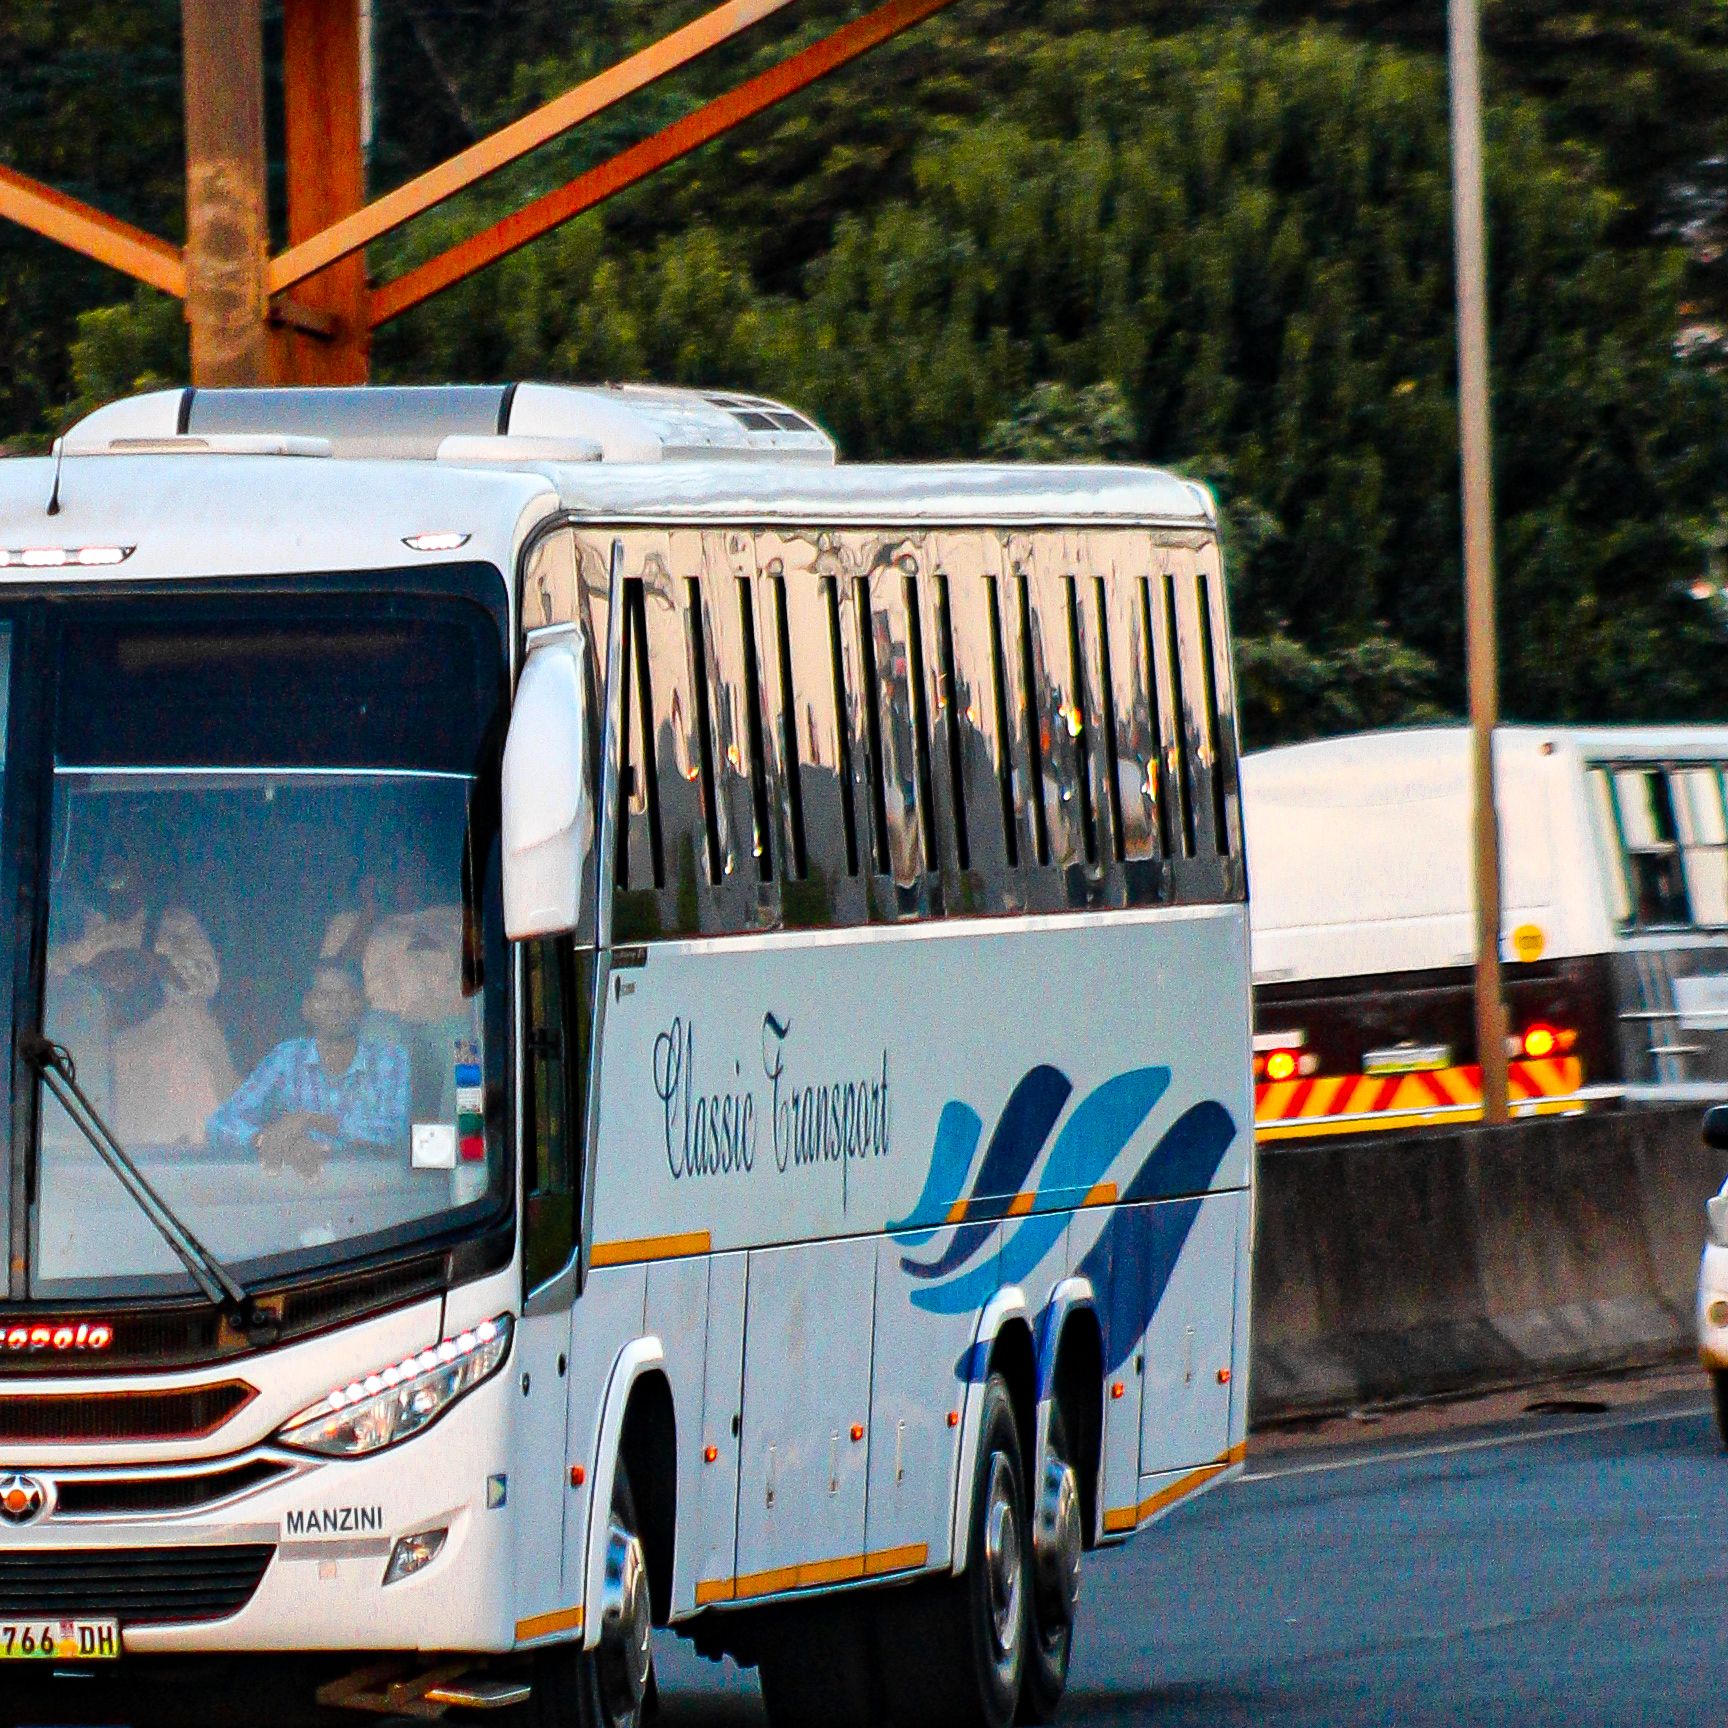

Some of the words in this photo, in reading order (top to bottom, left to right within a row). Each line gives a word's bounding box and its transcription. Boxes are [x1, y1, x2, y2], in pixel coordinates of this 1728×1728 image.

[653, 1016, 757, 1180] Classic
[762, 1011, 889, 1218] Transport
[286, 1505, 383, 1535] MANZINI
[2, 1625, 55, 1656] 766
[78, 1626, 114, 1655] DH
